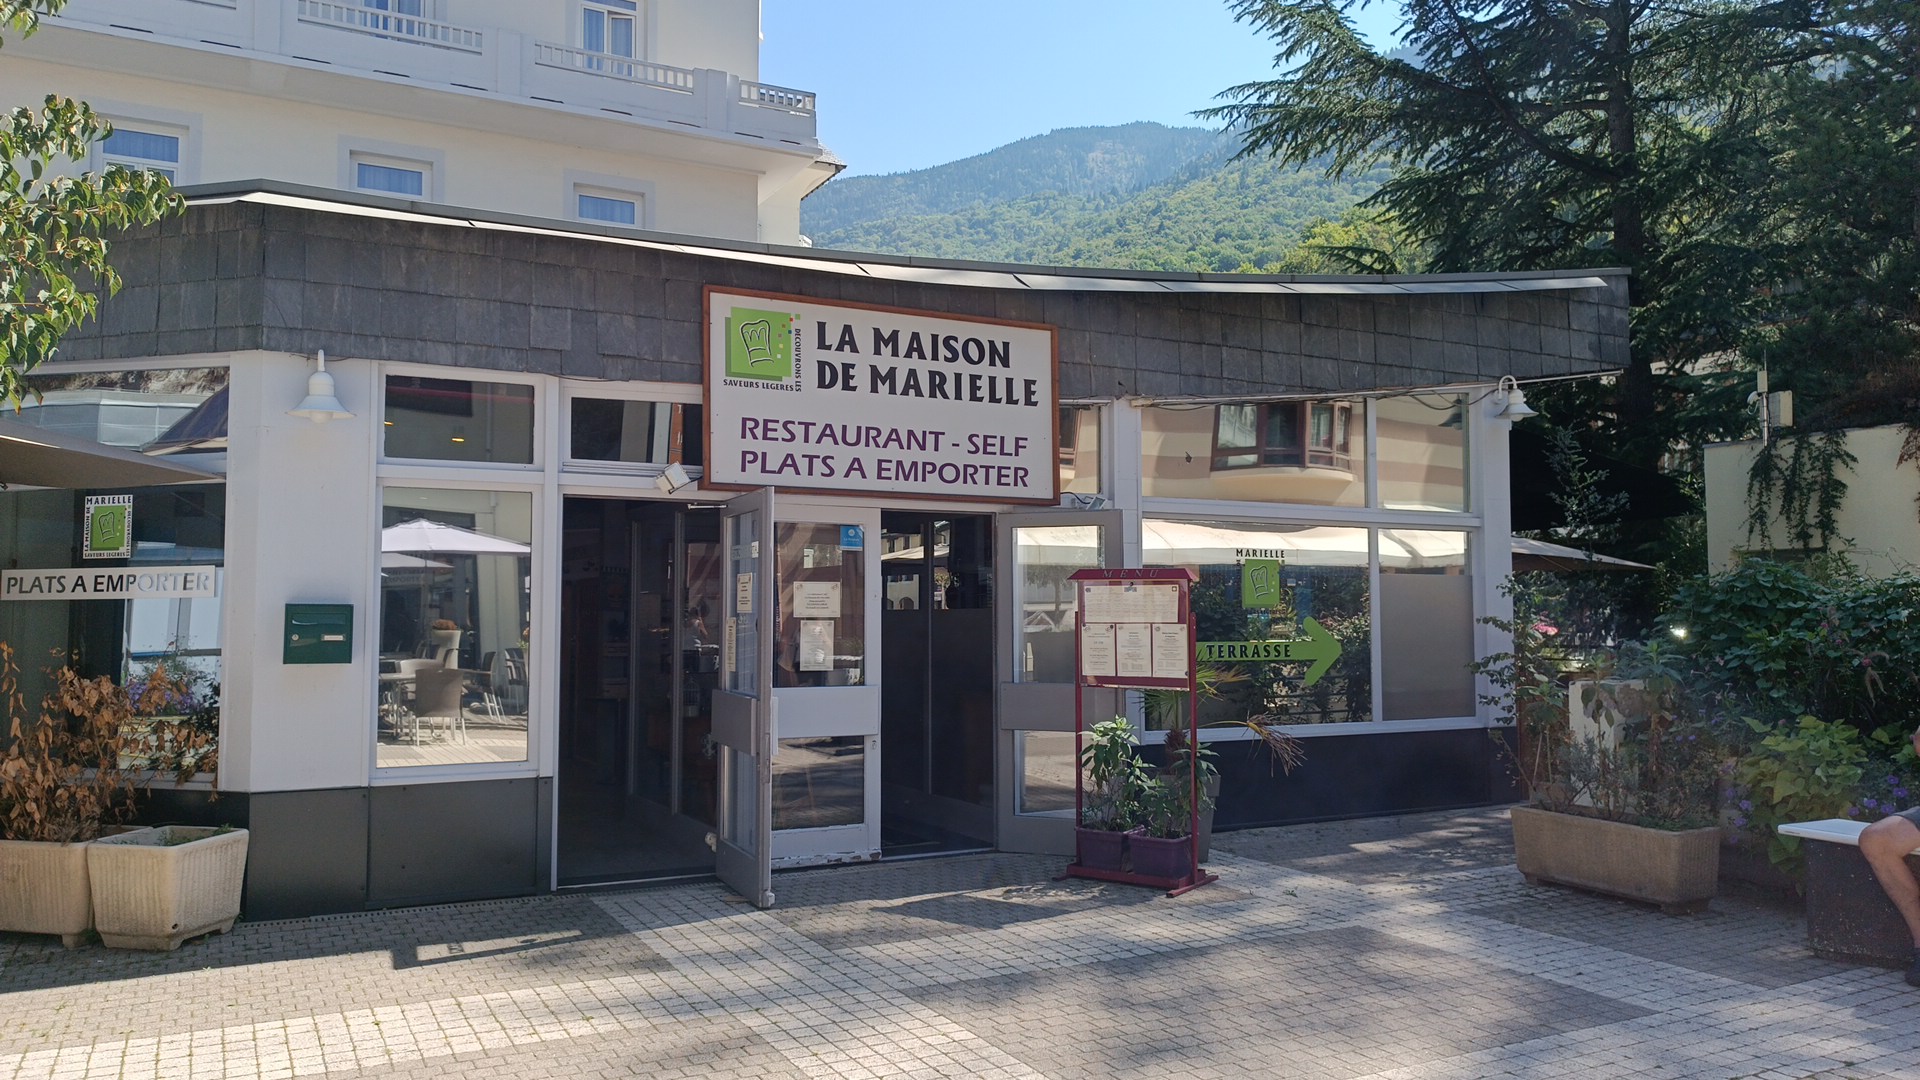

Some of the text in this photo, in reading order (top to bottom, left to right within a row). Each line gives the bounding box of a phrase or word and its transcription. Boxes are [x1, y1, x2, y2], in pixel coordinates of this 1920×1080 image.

[816, 321, 1011, 369] LA MAISON
[794, 328, 802, 392] DECOUVRONS LES
[723, 379, 794, 392] SAVEURS LEGERES
[816, 360, 1039, 407] DE MARIELLE
[740, 417, 945, 452] RESTAURANT
[967, 433, 1029, 457] SELF
[740, 450, 1029, 487] PLATS A EMPORTER
[86, 496, 132, 505] MARIELLE
[1236, 549, 1285, 558] MARIELLE
[6, 572, 210, 595] PLATS A EMPORTER
[1102, 569, 1159, 578] MENU
[1206, 644, 1291, 659] TERRASSE
